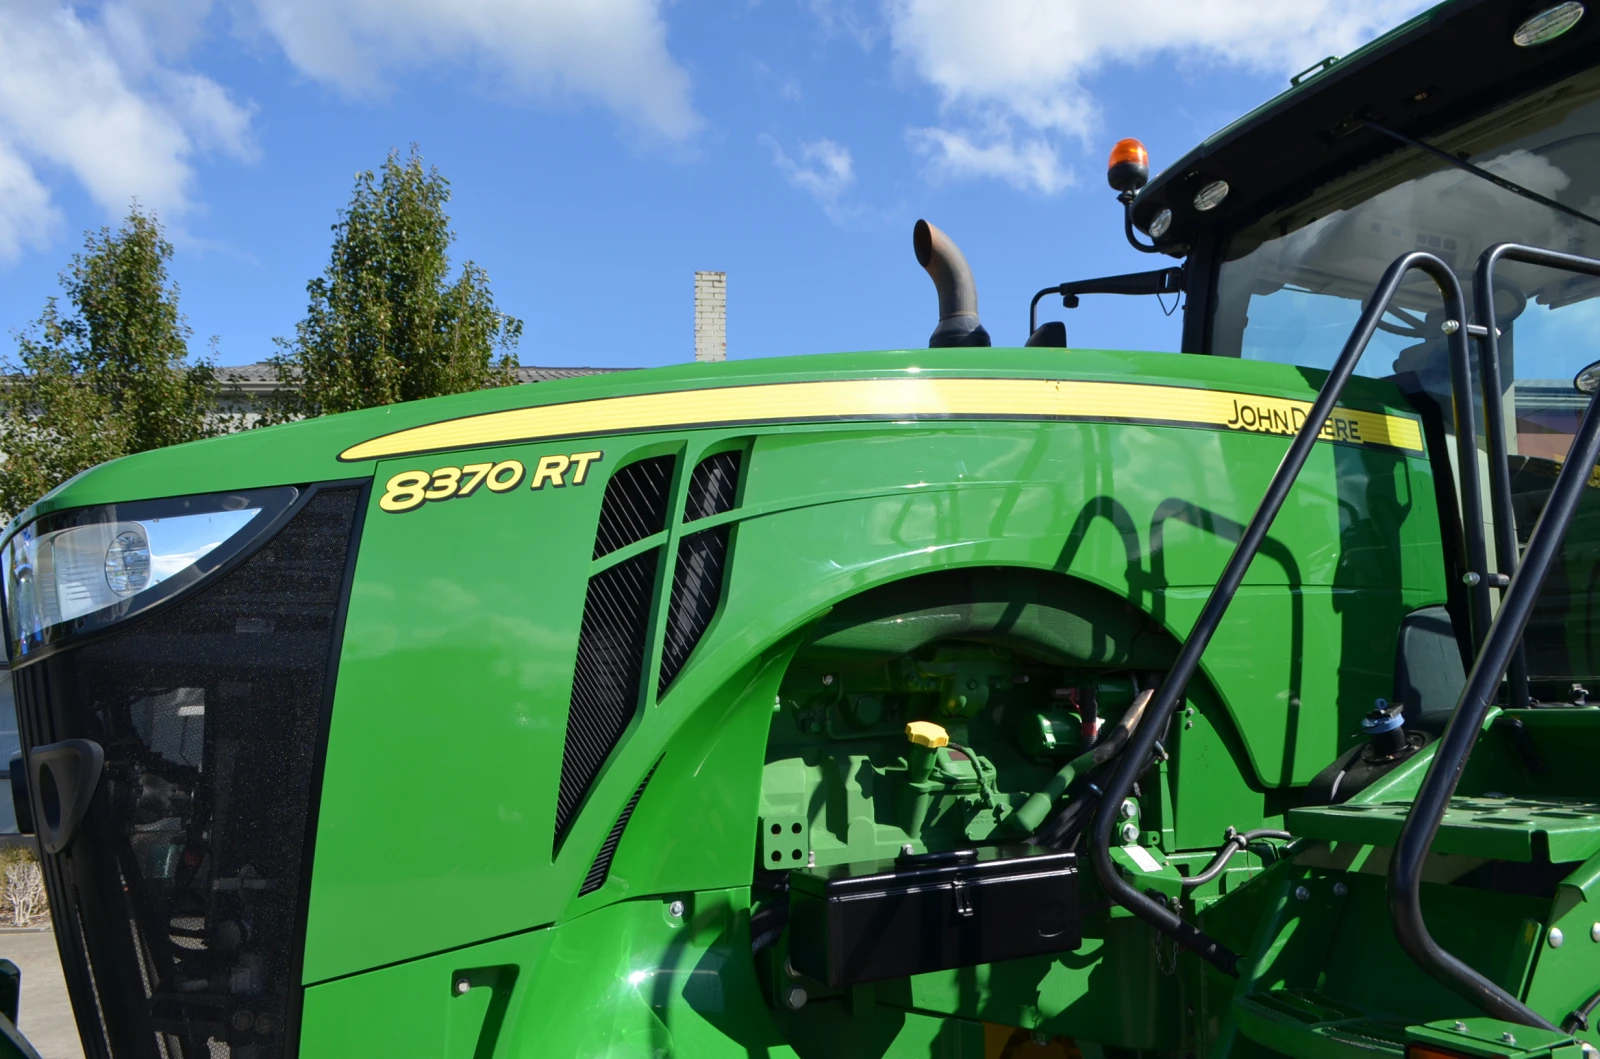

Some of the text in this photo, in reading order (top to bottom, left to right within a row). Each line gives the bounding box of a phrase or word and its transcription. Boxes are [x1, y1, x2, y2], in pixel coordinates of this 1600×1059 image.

[1227, 399, 1361, 440] JOHN DERE
[379, 450, 604, 514] 8370 RT
